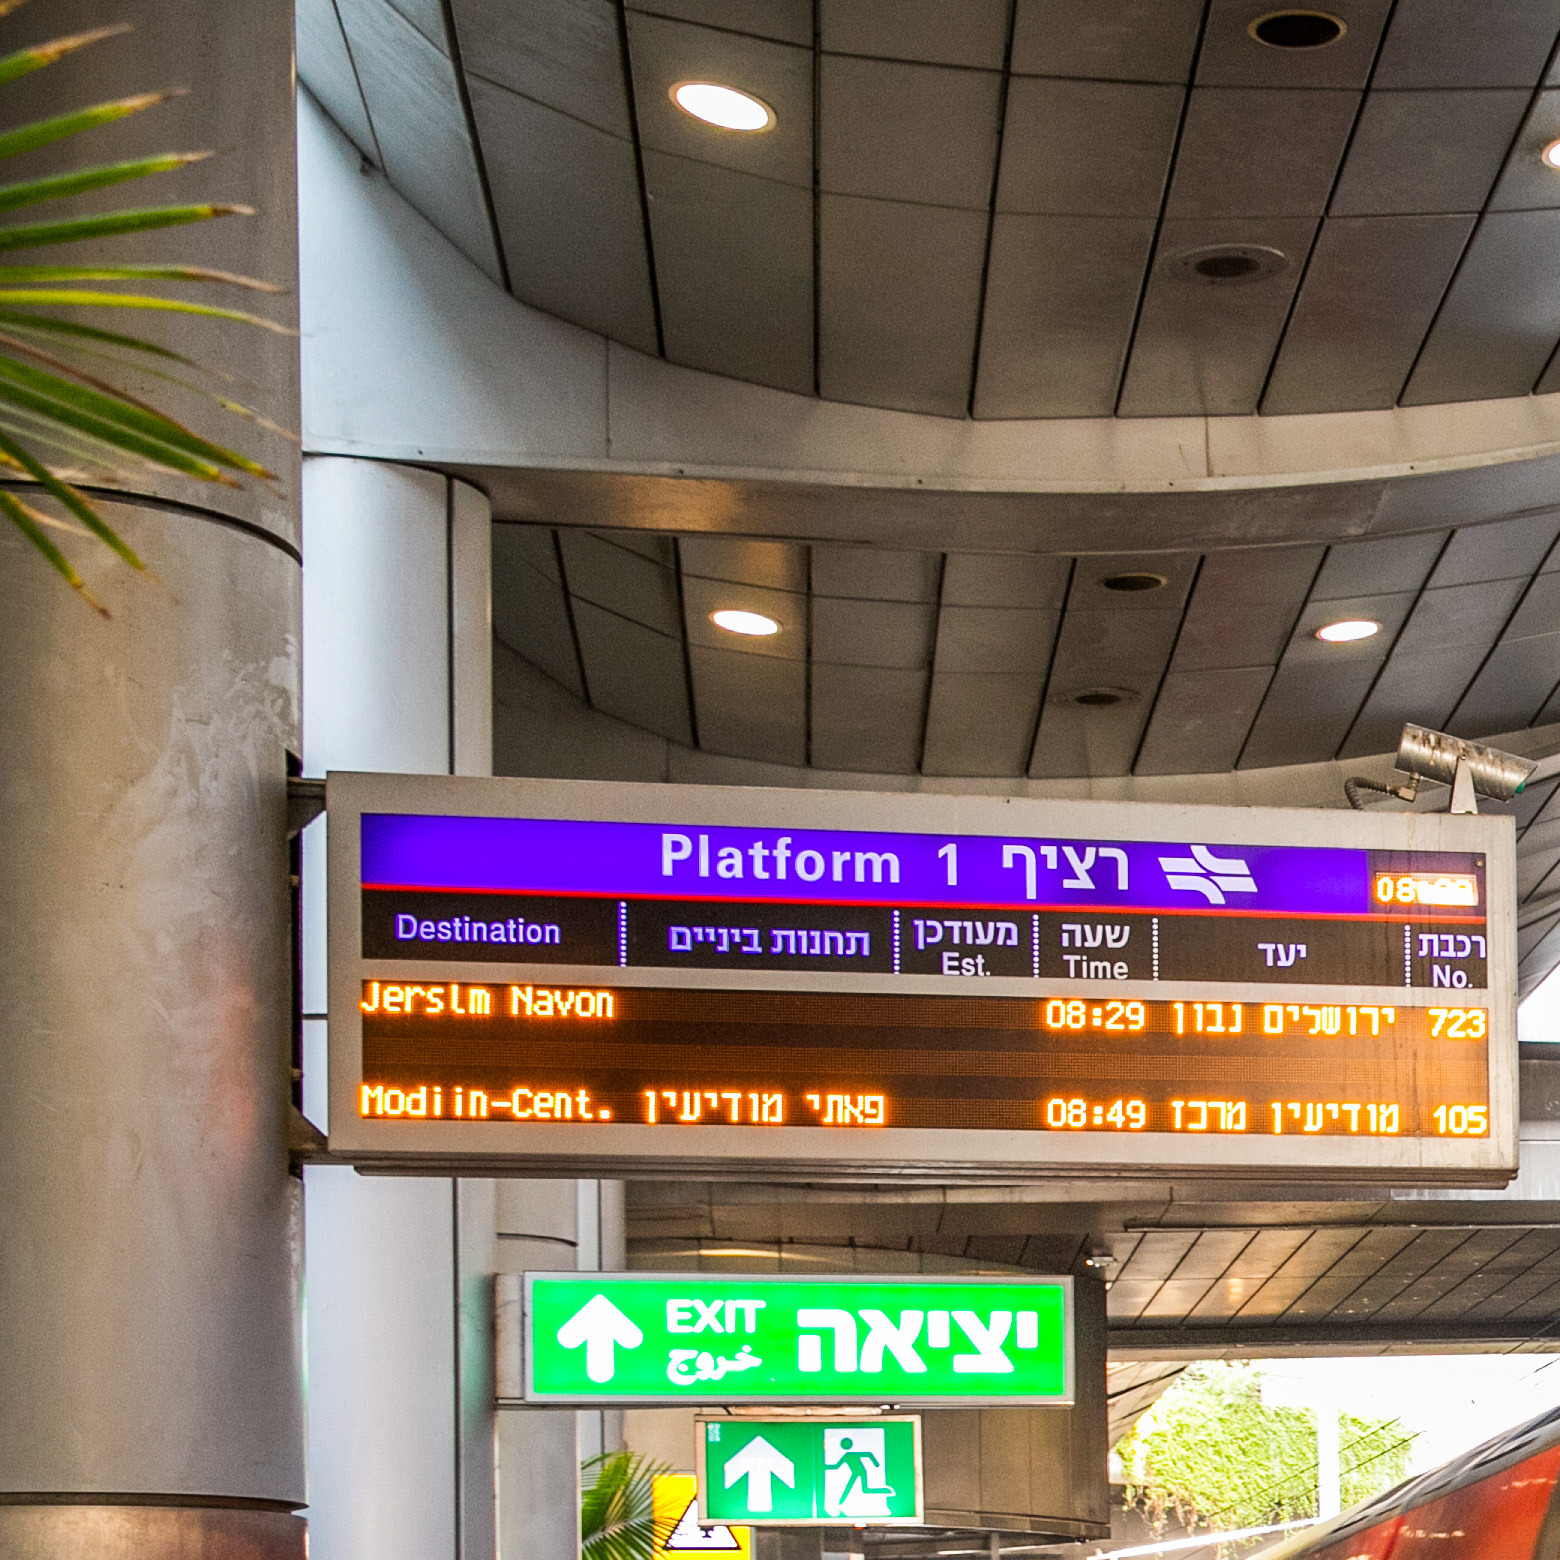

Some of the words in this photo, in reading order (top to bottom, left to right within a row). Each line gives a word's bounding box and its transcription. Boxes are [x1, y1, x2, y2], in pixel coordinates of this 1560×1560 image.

[661, 832, 901, 883] Platform
[937, 843, 959, 886] 1
[1001, 844, 1130, 900] רציף
[397, 914, 562, 945] Destination
[668, 925, 763, 954] ביניים
[770, 929, 870, 956] תחנות
[912, 919, 1019, 951] מעודכן
[1060, 923, 1131, 949] שעה
[1419, 931, 1487, 959] רכבת
[941, 951, 991, 977] Est.
[1062, 954, 1129, 980] Time
[1258, 941, 1308, 968] יעד
[1432, 965, 1474, 989] No.
[510, 985, 614, 1018] Navon
[1046, 999, 1146, 1032] 08:29
[1173, 1002, 1243, 1034] נבון
[1263, 1005, 1396, 1036] ירושלים
[1428, 1007, 1487, 1038] 723
[360, 1085, 612, 1120] Modiin-Cent.
[645, 1091, 784, 1123] מודיעין
[1046, 1098, 1147, 1131] 08:49
[1172, 1100, 1247, 1131] מרכז
[1271, 1101, 1400, 1133] מודיעין
[1433, 1104, 1488, 1134] 105
[666, 1299, 767, 1334] EXIT
[797, 1309, 1039, 1373] יציאה
[666, 1345, 763, 1386] خروج
